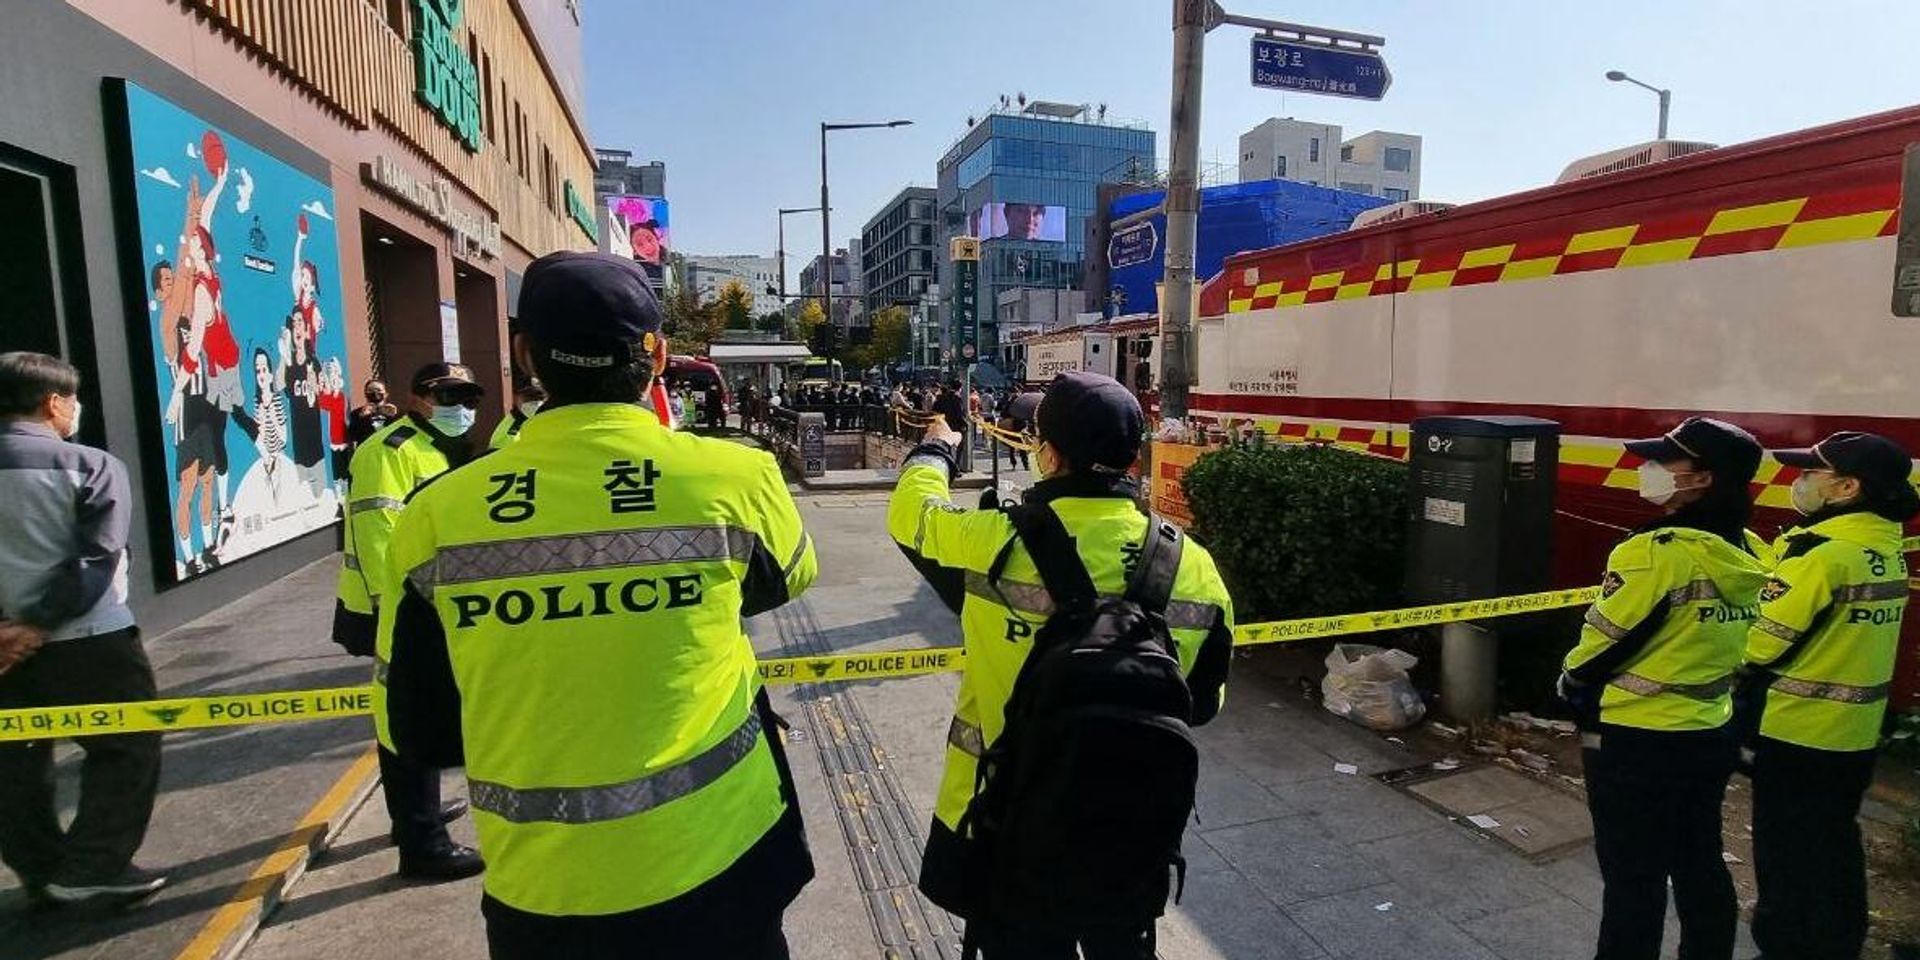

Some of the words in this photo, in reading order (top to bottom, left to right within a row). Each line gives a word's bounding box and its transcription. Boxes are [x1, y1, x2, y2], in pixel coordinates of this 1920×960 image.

[1258, 47, 1304, 68] 보광로
[450, 574, 703, 628] POLICE
[1849, 606, 1901, 625] POLI
[1271, 622, 1315, 637] POLICE
[1318, 619, 1346, 632] LINE
[845, 657, 905, 673] POLICE
[911, 654, 947, 668] LINE
[209, 699, 304, 719] POLICE
[315, 694, 371, 712] LINE
